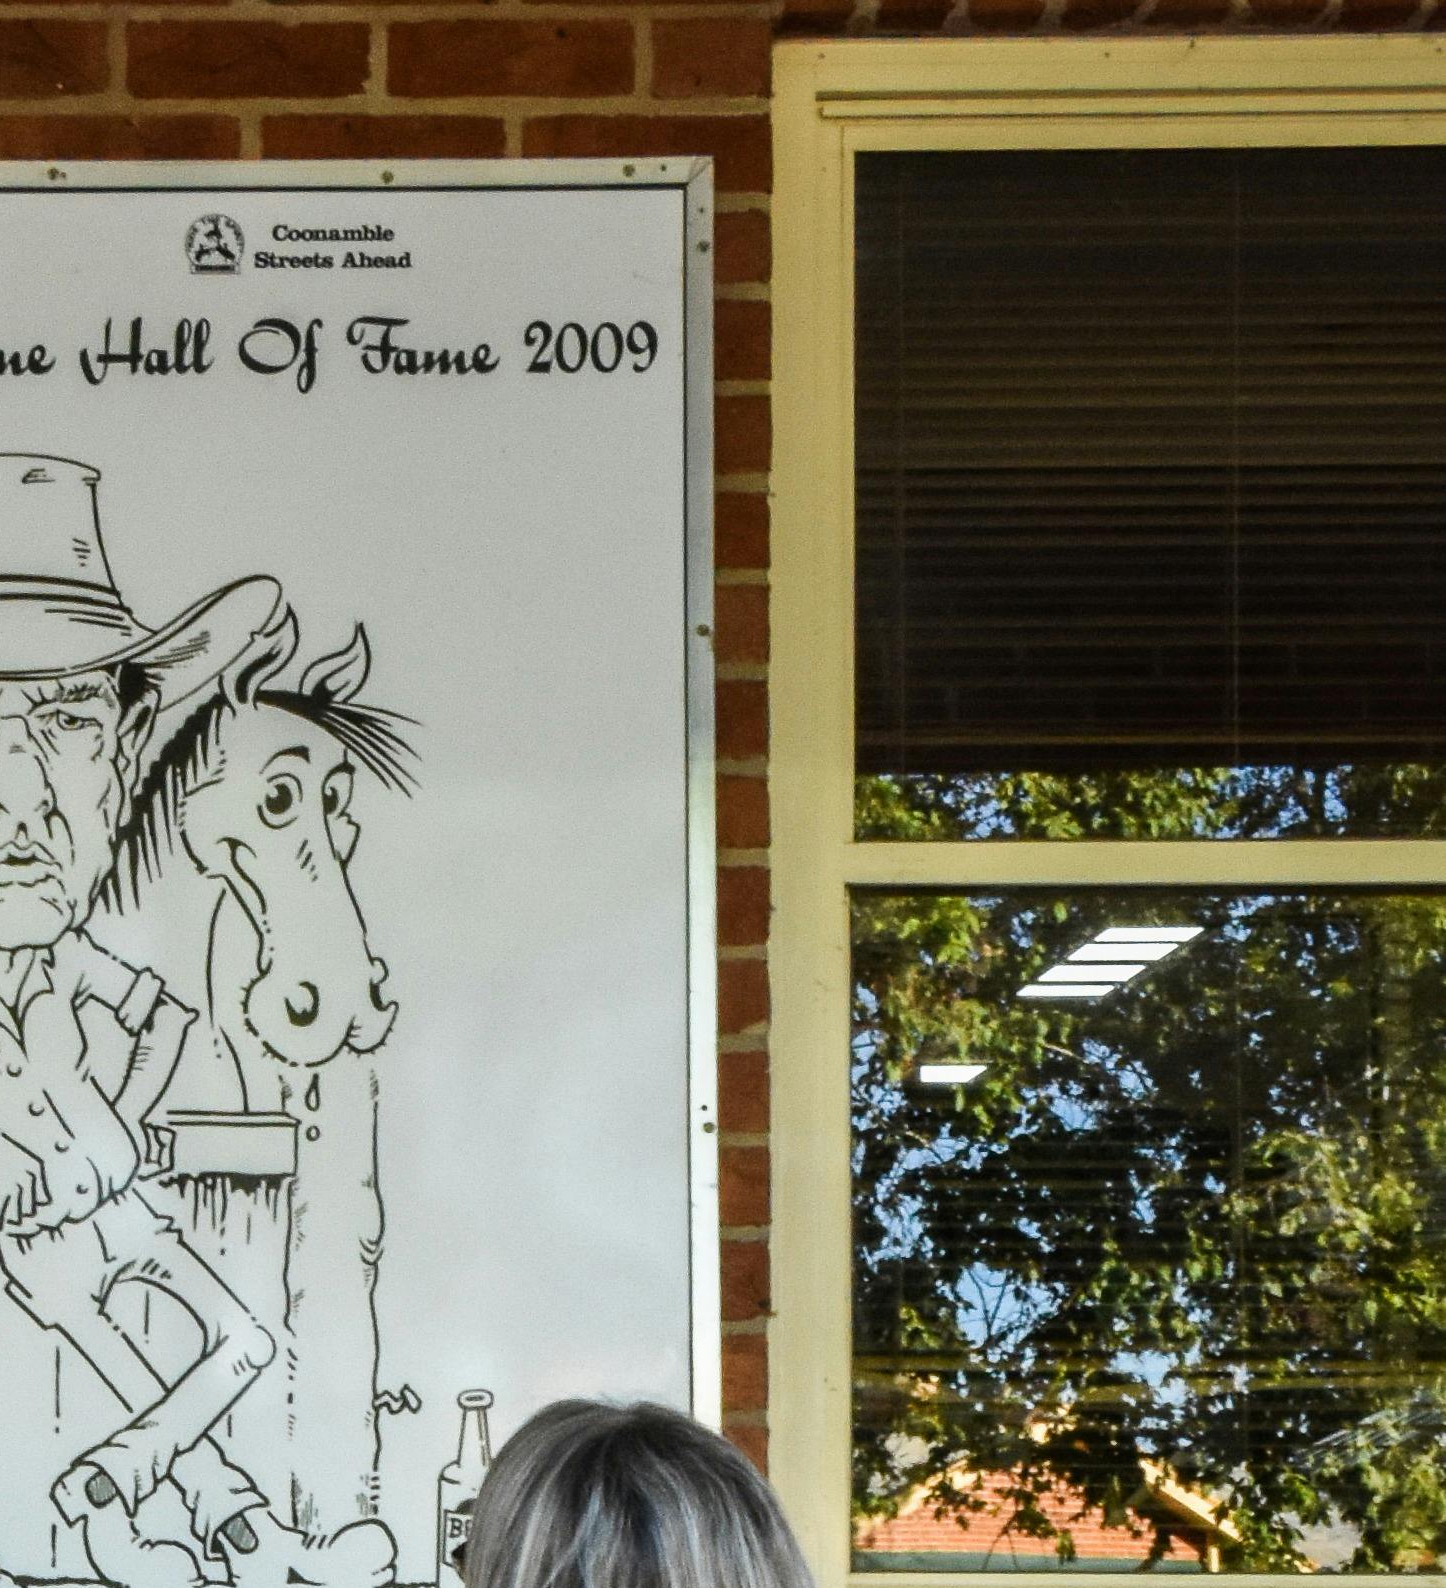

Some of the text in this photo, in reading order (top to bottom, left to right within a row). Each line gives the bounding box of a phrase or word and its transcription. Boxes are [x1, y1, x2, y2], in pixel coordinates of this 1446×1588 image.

[272, 224, 395, 242] Coonamble
[254, 251, 334, 269] Streets
[341, 251, 412, 269] Ahead
[79, 316, 214, 386] Hall
[238, 317, 323, 394] Of
[346, 315, 500, 376] Fame
[524, 319, 659, 375] 2009
